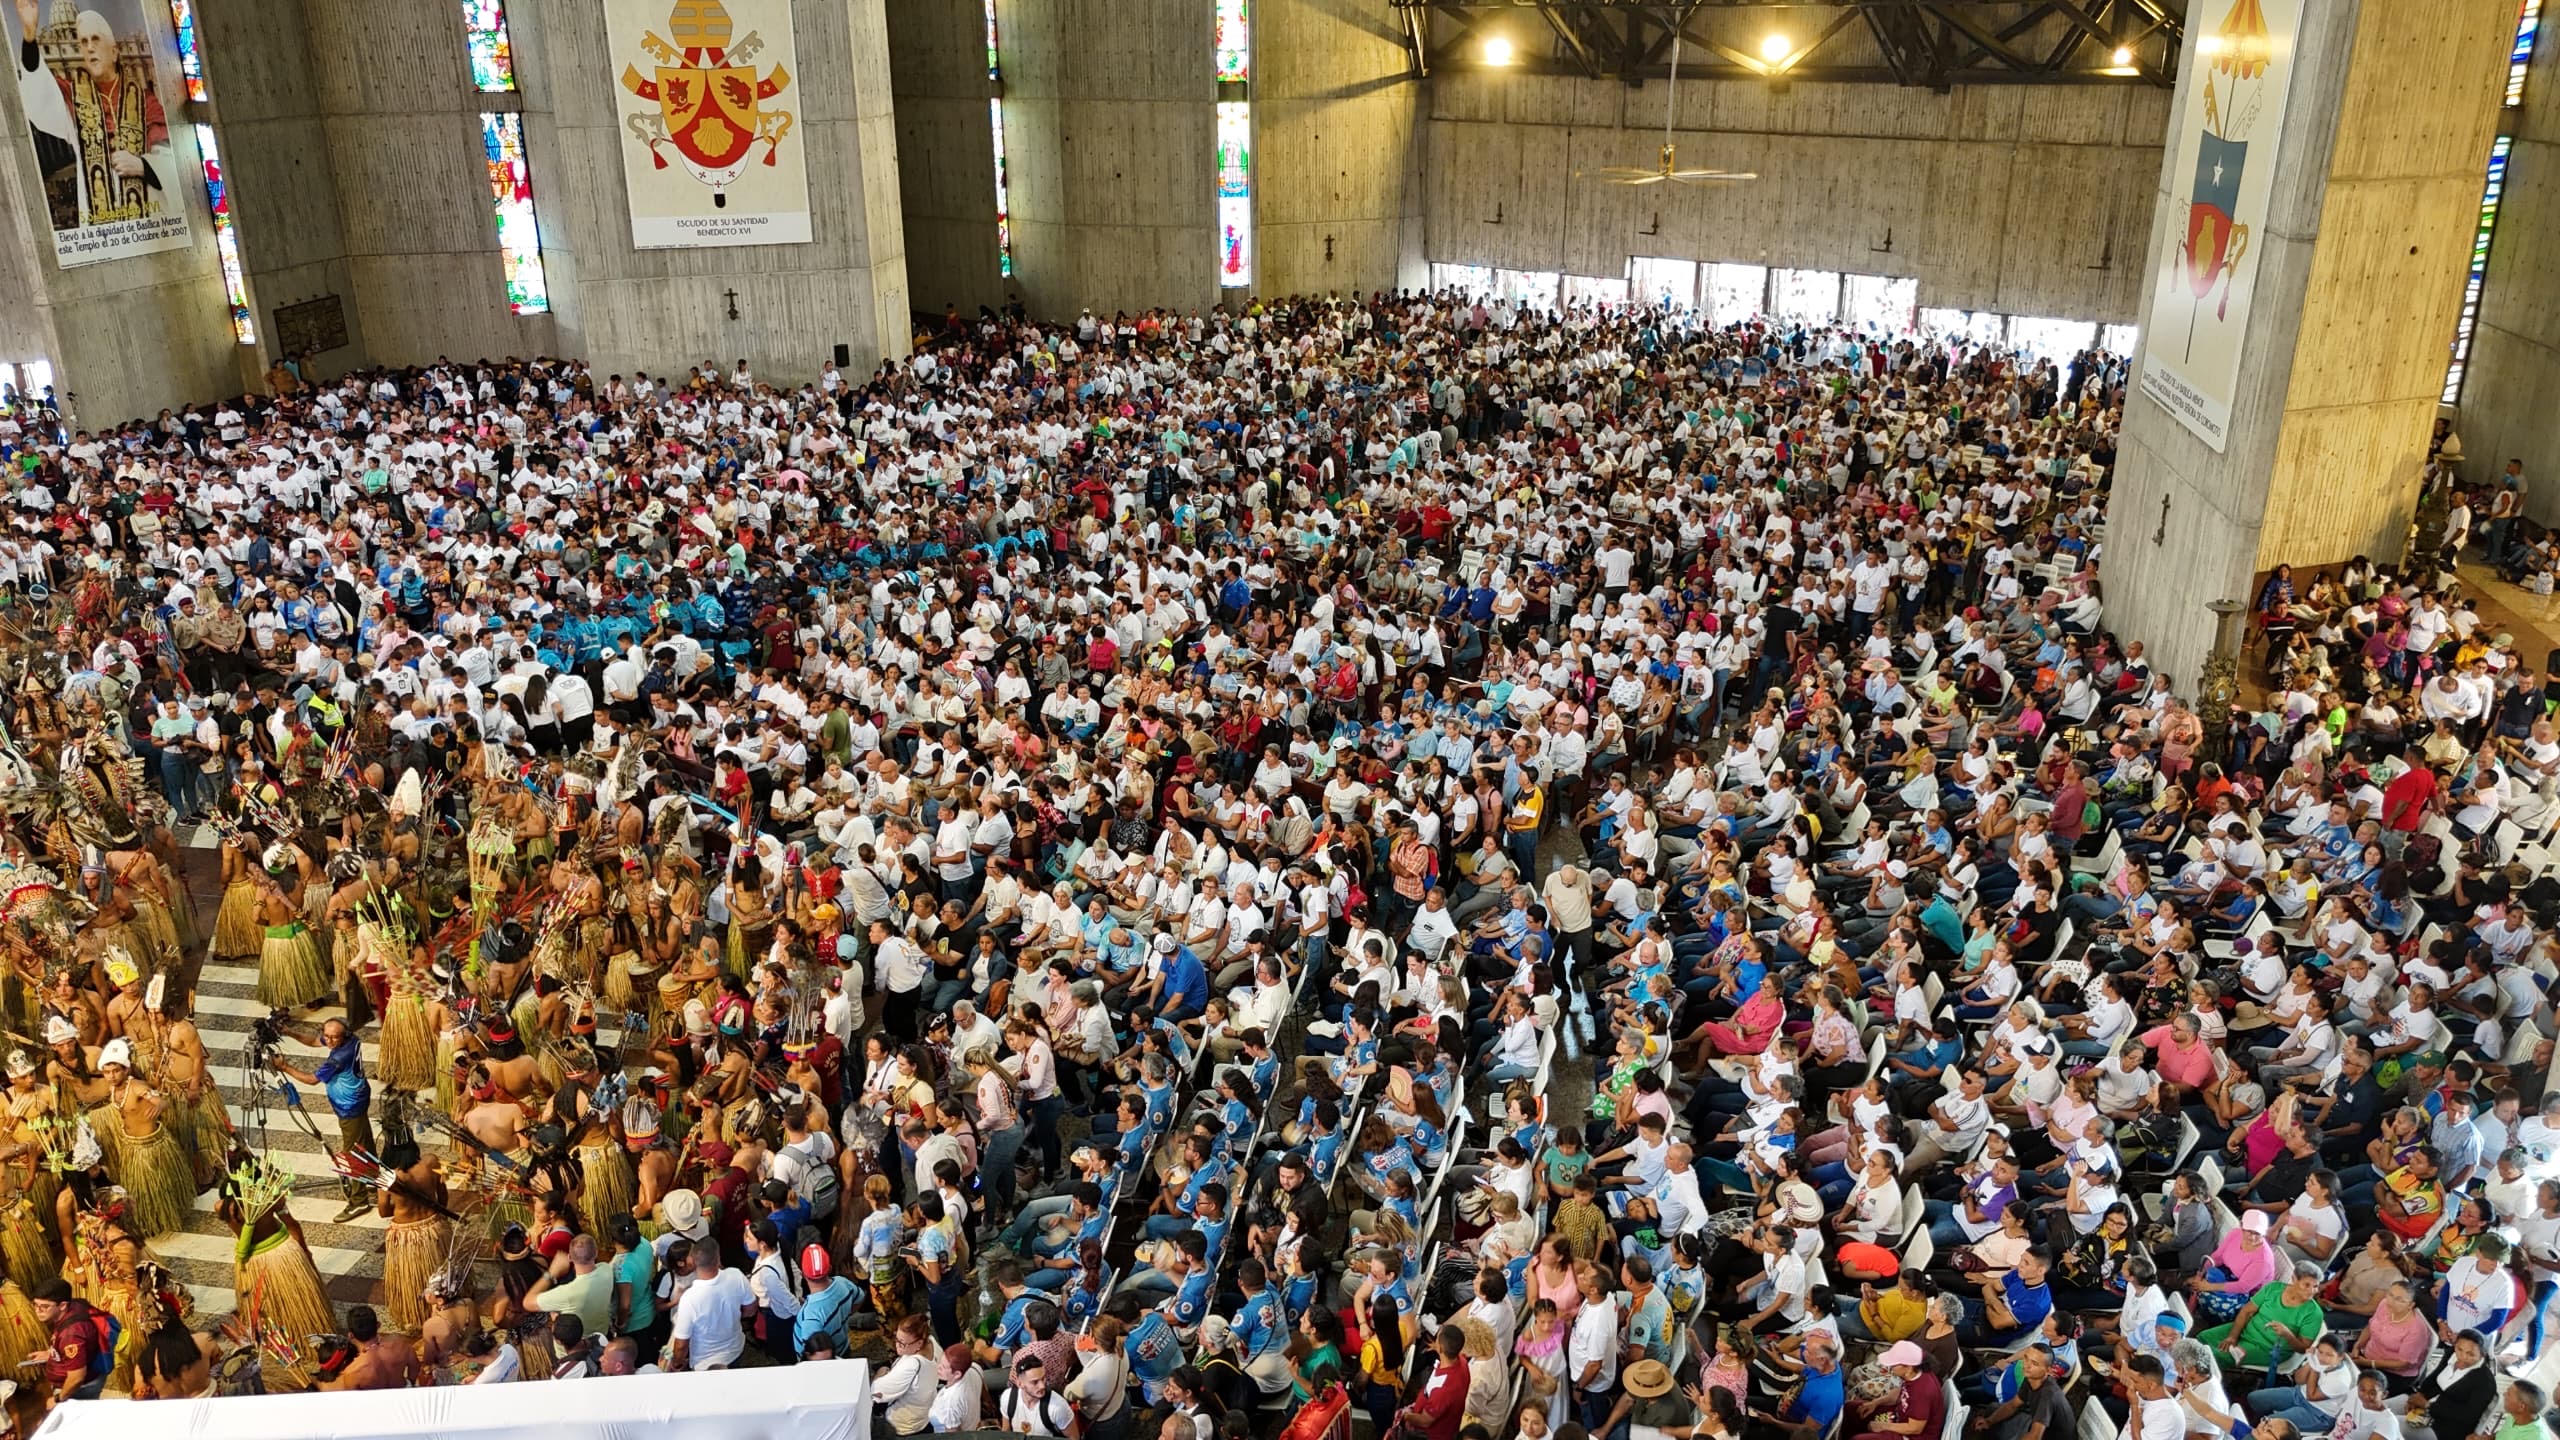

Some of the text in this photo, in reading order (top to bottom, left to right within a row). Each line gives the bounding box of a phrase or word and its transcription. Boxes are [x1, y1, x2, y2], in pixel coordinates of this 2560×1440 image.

[676, 217, 768, 227] ESCUDO DE SU SANTIDAD
[59, 231, 79, 242] Elevó
[86, 228, 94, 239] la
[96, 223, 125, 239] dignidad
[126, 222, 135, 232] de
[161, 216, 182, 227] Menor
[696, 226, 751, 236] BENEDICTO XVI
[58, 226, 187, 255] este Templo el 20 de Octubre de 2007
[1424, 439, 1434, 448] 01
